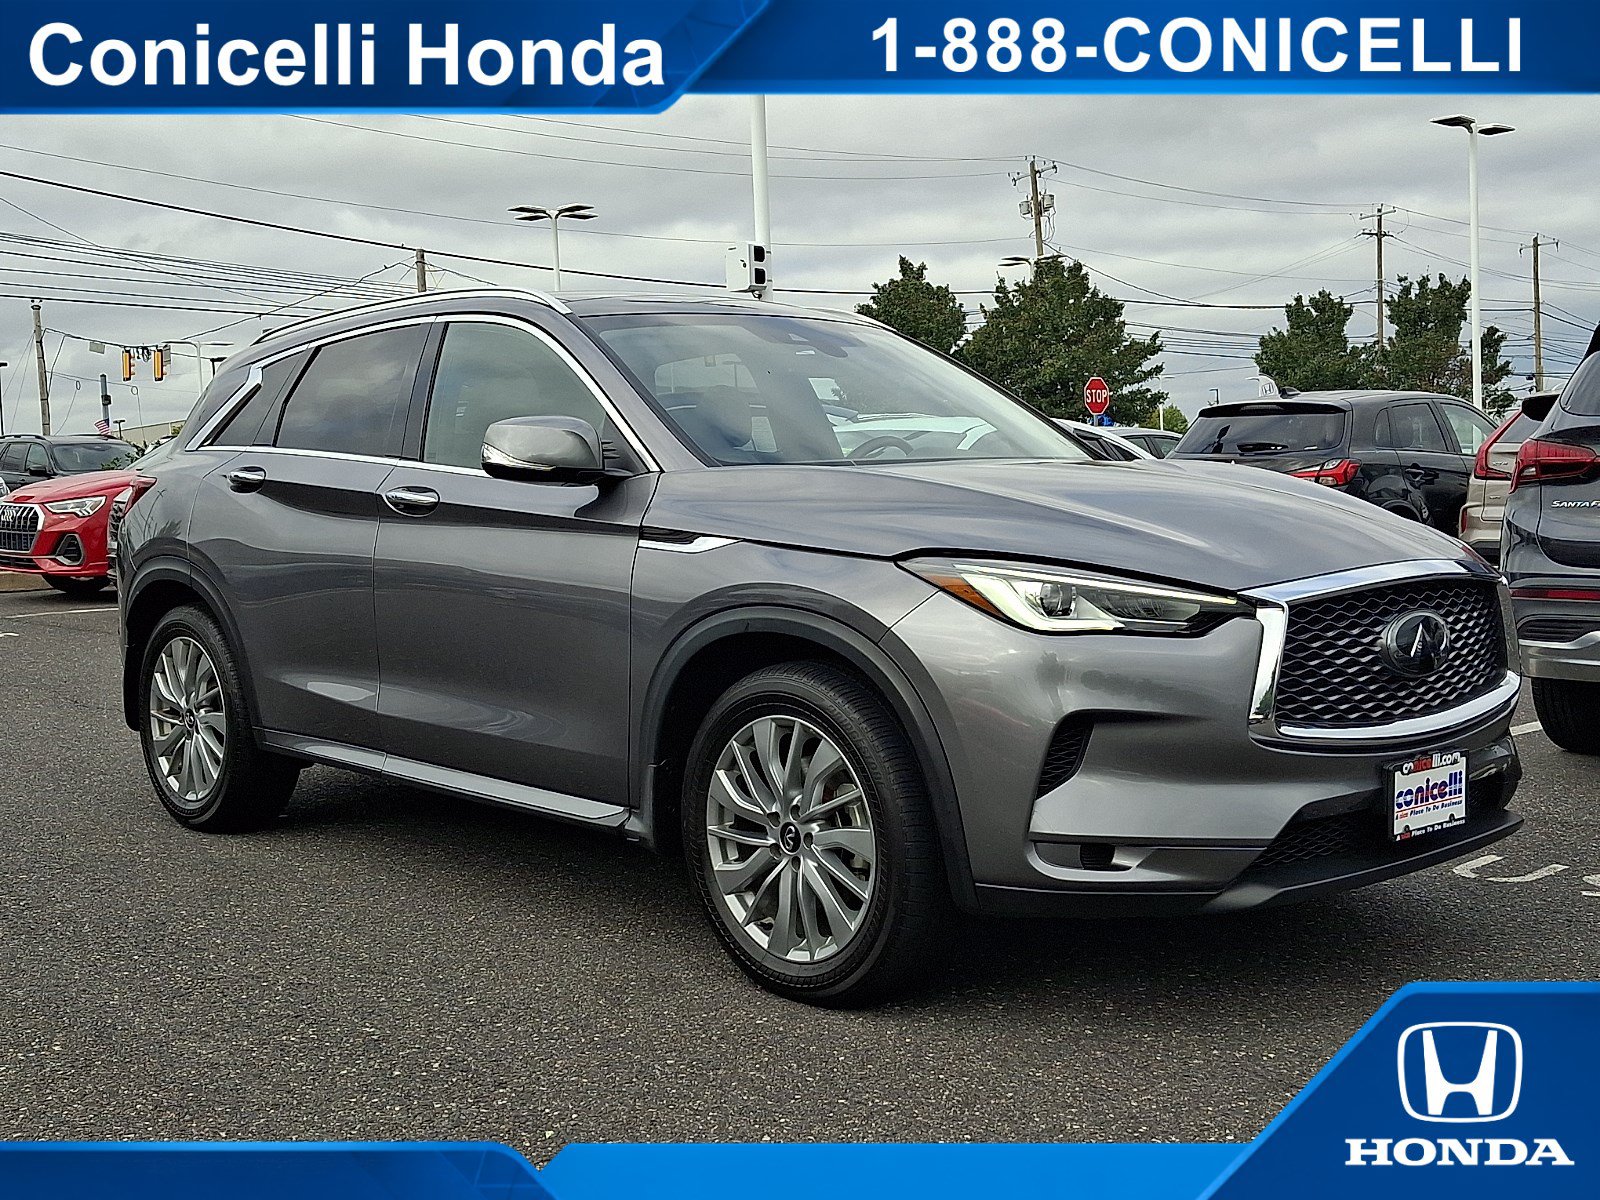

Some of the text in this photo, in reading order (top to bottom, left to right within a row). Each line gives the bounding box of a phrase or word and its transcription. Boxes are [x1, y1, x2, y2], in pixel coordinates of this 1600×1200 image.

[1086, 389, 1107, 403] STOP
[1551, 500, 1589, 508] SANTA
[1402, 752, 1460, 773] conicelli.com
[1396, 770, 1463, 809] conicelli
[1410, 807, 1424, 816] Place
[1441, 799, 1463, 809] Business
[1411, 829, 1426, 837] Place
[1443, 819, 1466, 828] Business
